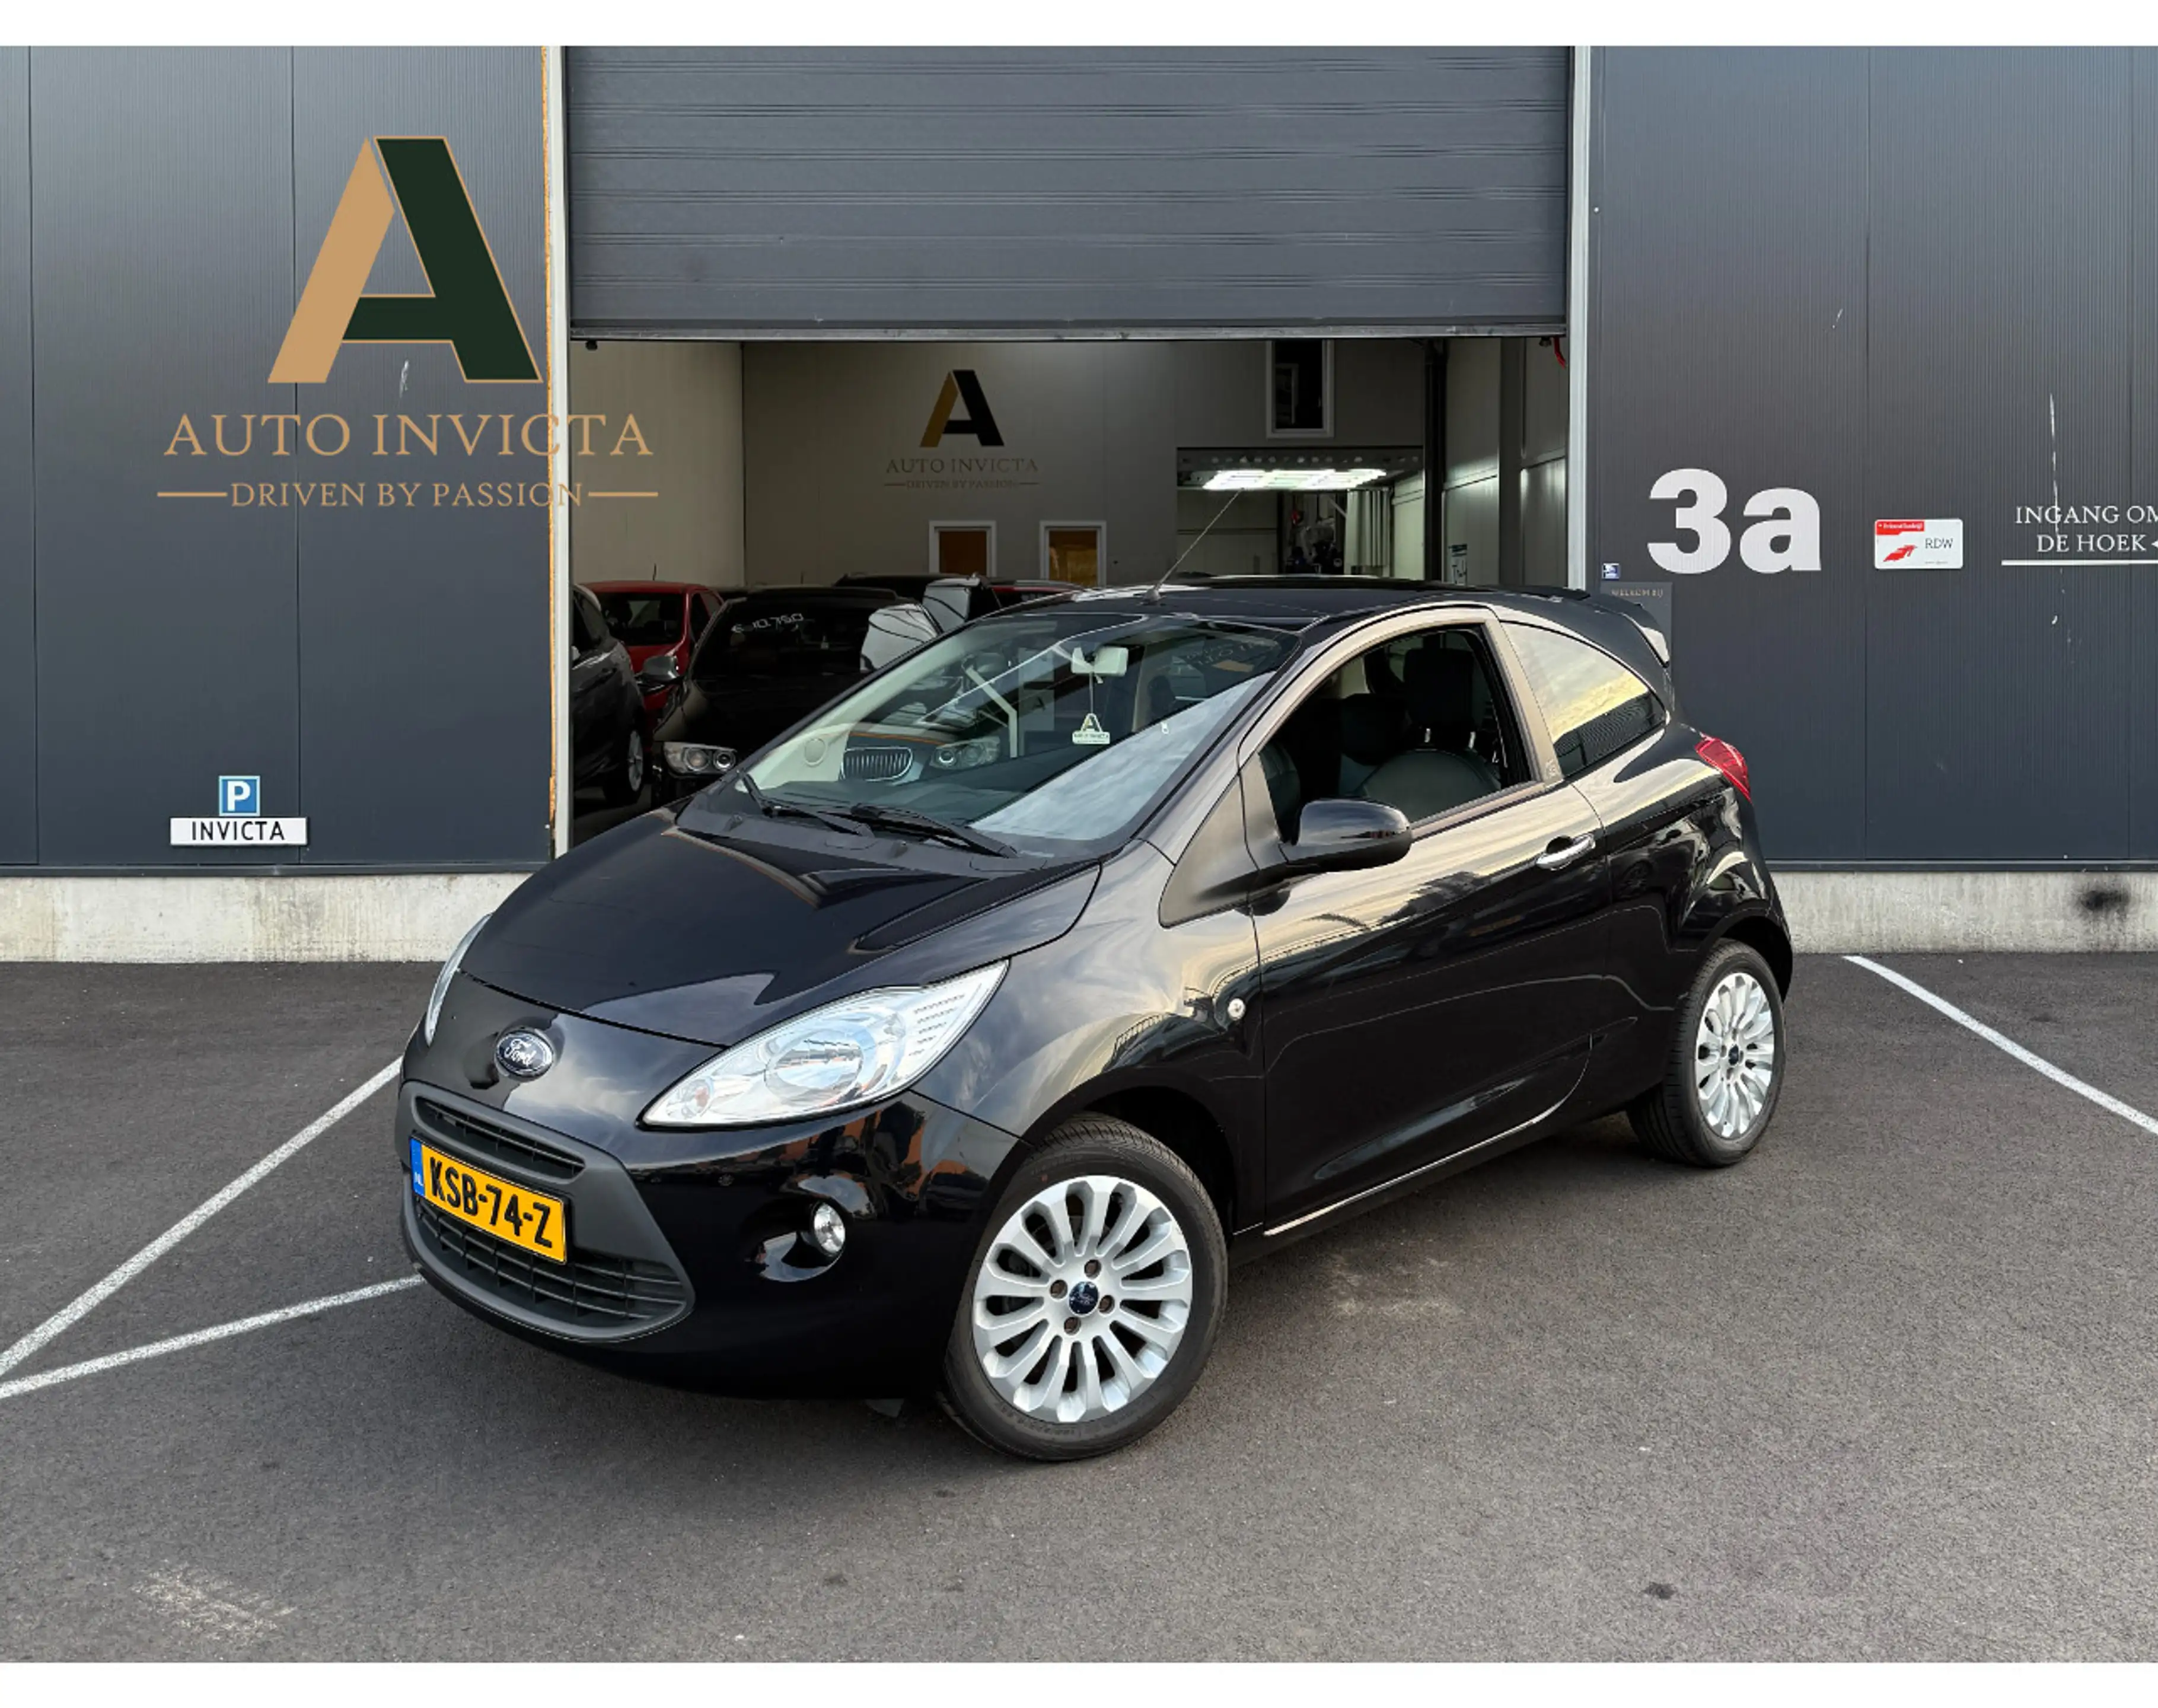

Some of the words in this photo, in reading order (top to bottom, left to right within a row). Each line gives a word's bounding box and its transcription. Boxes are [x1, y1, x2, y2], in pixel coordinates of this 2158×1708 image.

[886, 458, 945, 473] AUTO
[950, 458, 1039, 473] INVICTA
[1647, 469, 1822, 574] 3a
[2015, 505, 2120, 524] INGANG
[1925, 538, 1953, 549] RDW
[2036, 534, 2070, 553] DE
[2077, 534, 2147, 553] HOEK
[192, 821, 285, 840] INVICTA
[504, 1038, 537, 1066] Ford
[430, 1156, 552, 1248] KSB-74-Z
